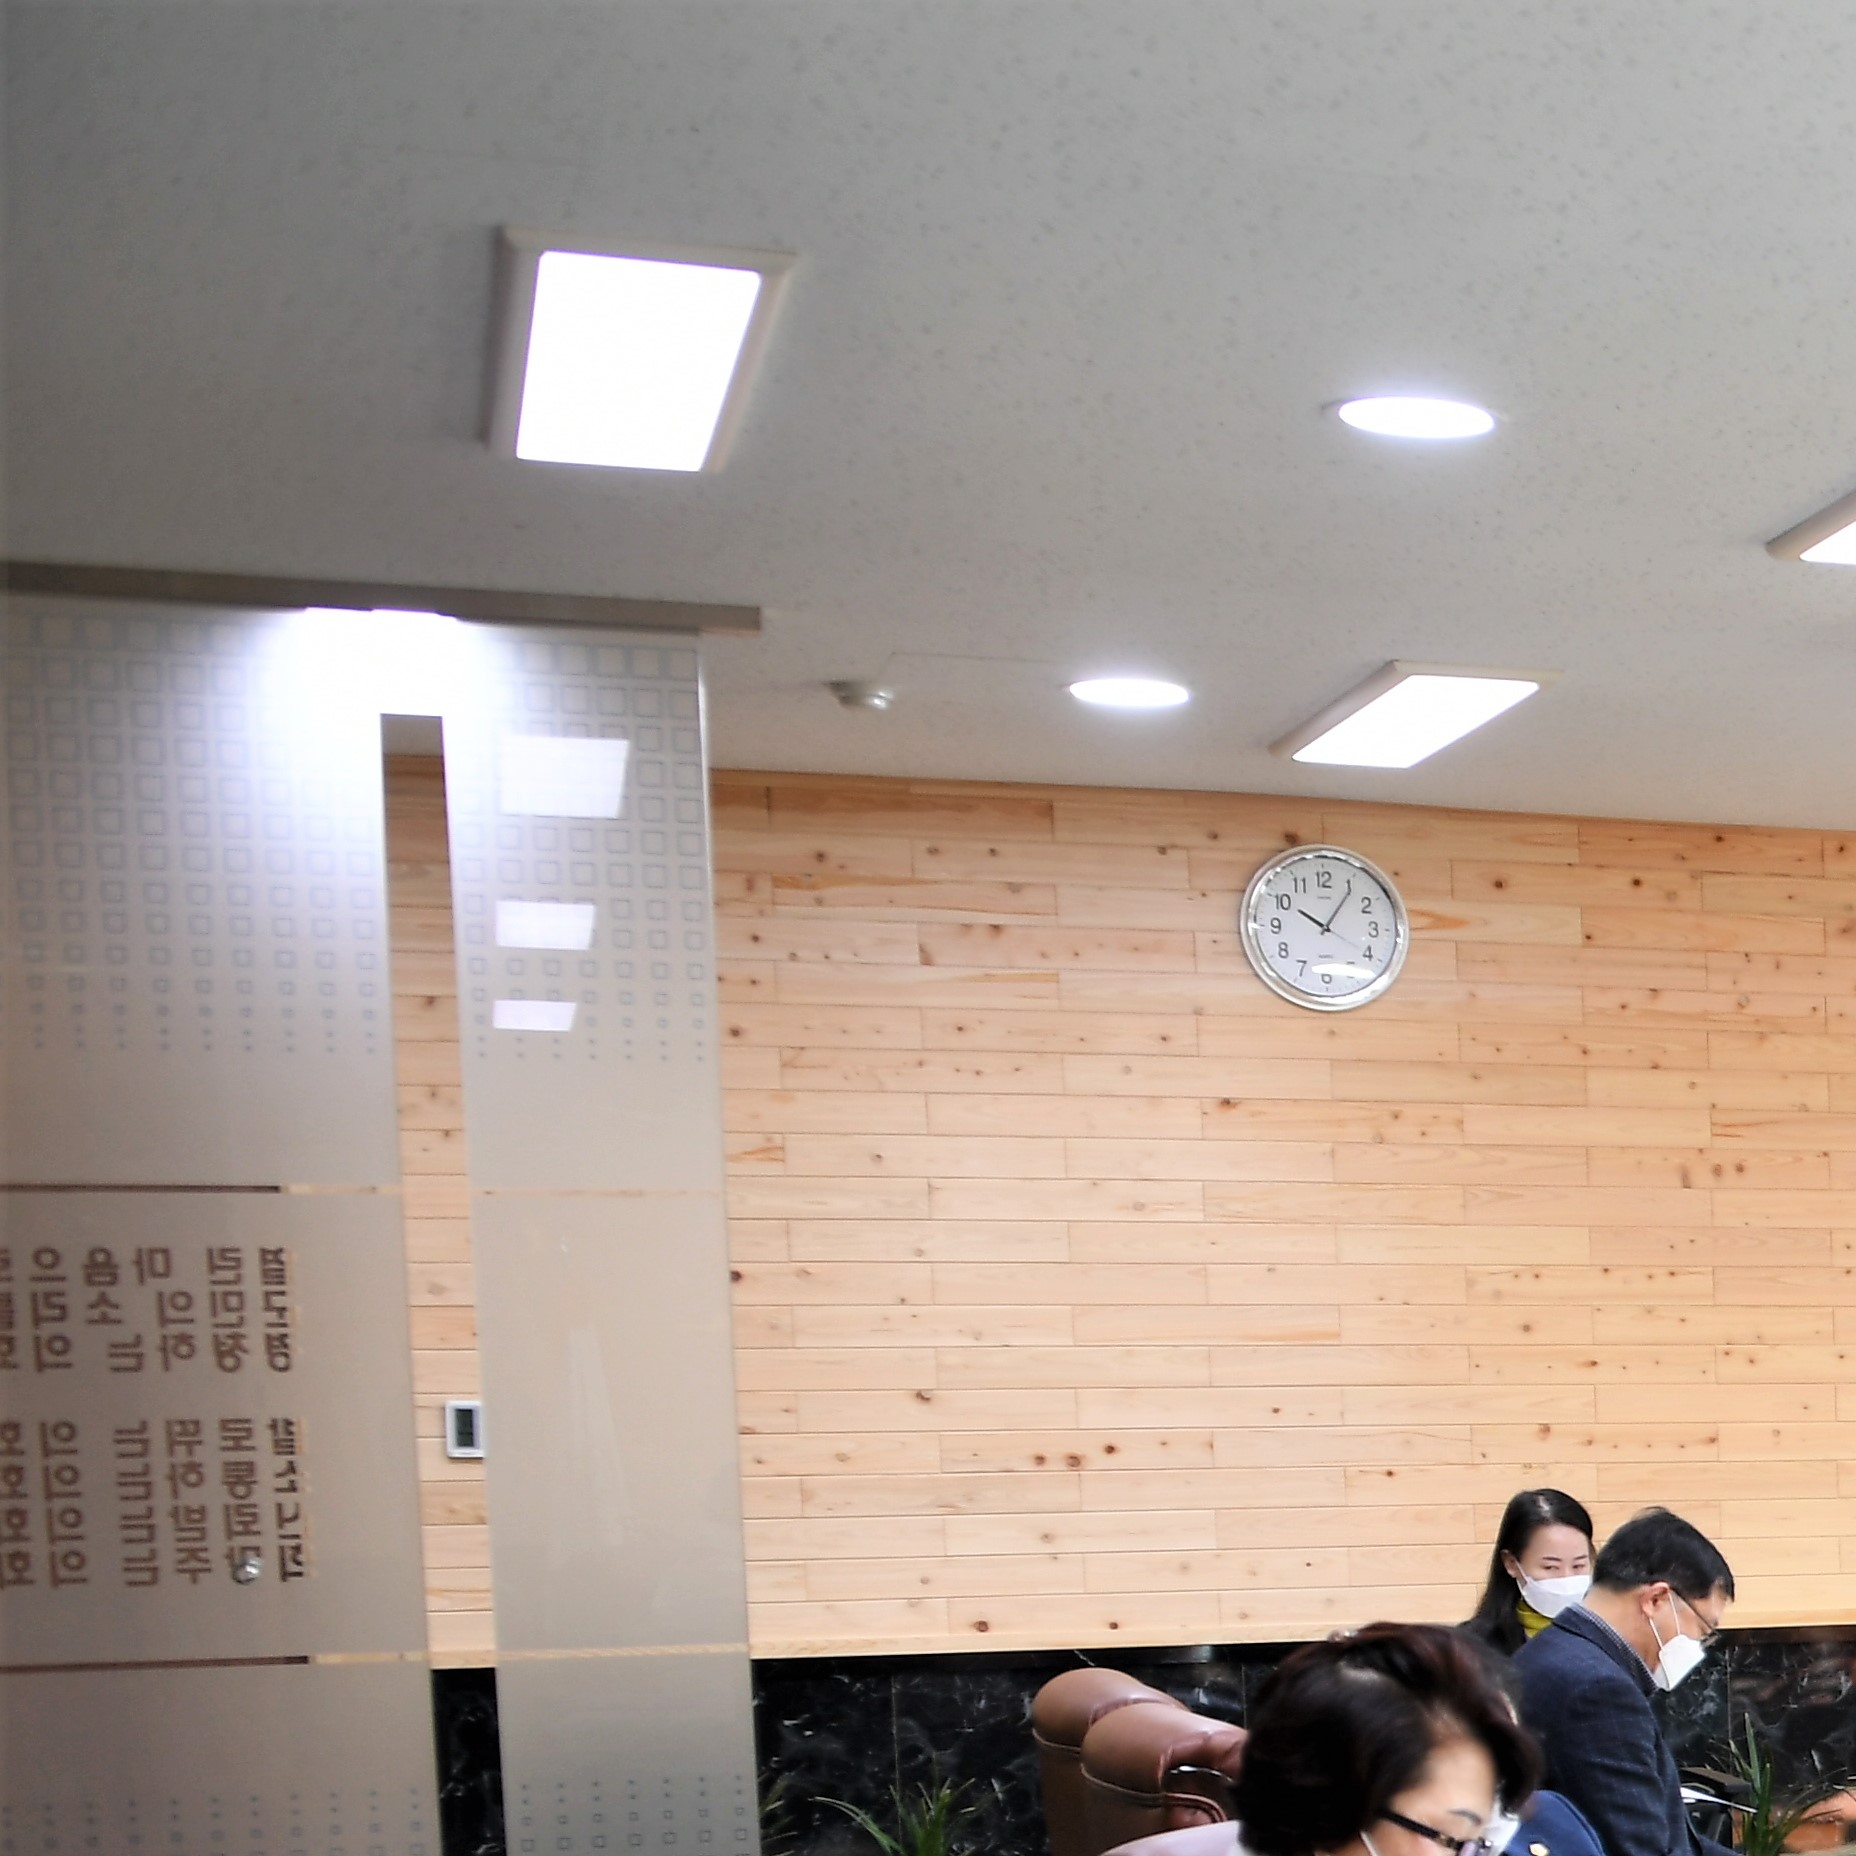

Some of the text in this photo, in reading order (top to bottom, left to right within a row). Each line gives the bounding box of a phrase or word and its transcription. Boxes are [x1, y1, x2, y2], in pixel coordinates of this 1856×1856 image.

[1293, 877, 1307, 894] 11
[1315, 871, 1333, 889] 12
[1275, 893, 1292, 911] 10
[1361, 897, 1372, 914] 2
[1270, 917, 1282, 935] 9
[1368, 920, 1380, 938] 3
[1278, 941, 1289, 959] 8
[1362, 945, 1375, 962] 4
[1296, 960, 1307, 977] 7
